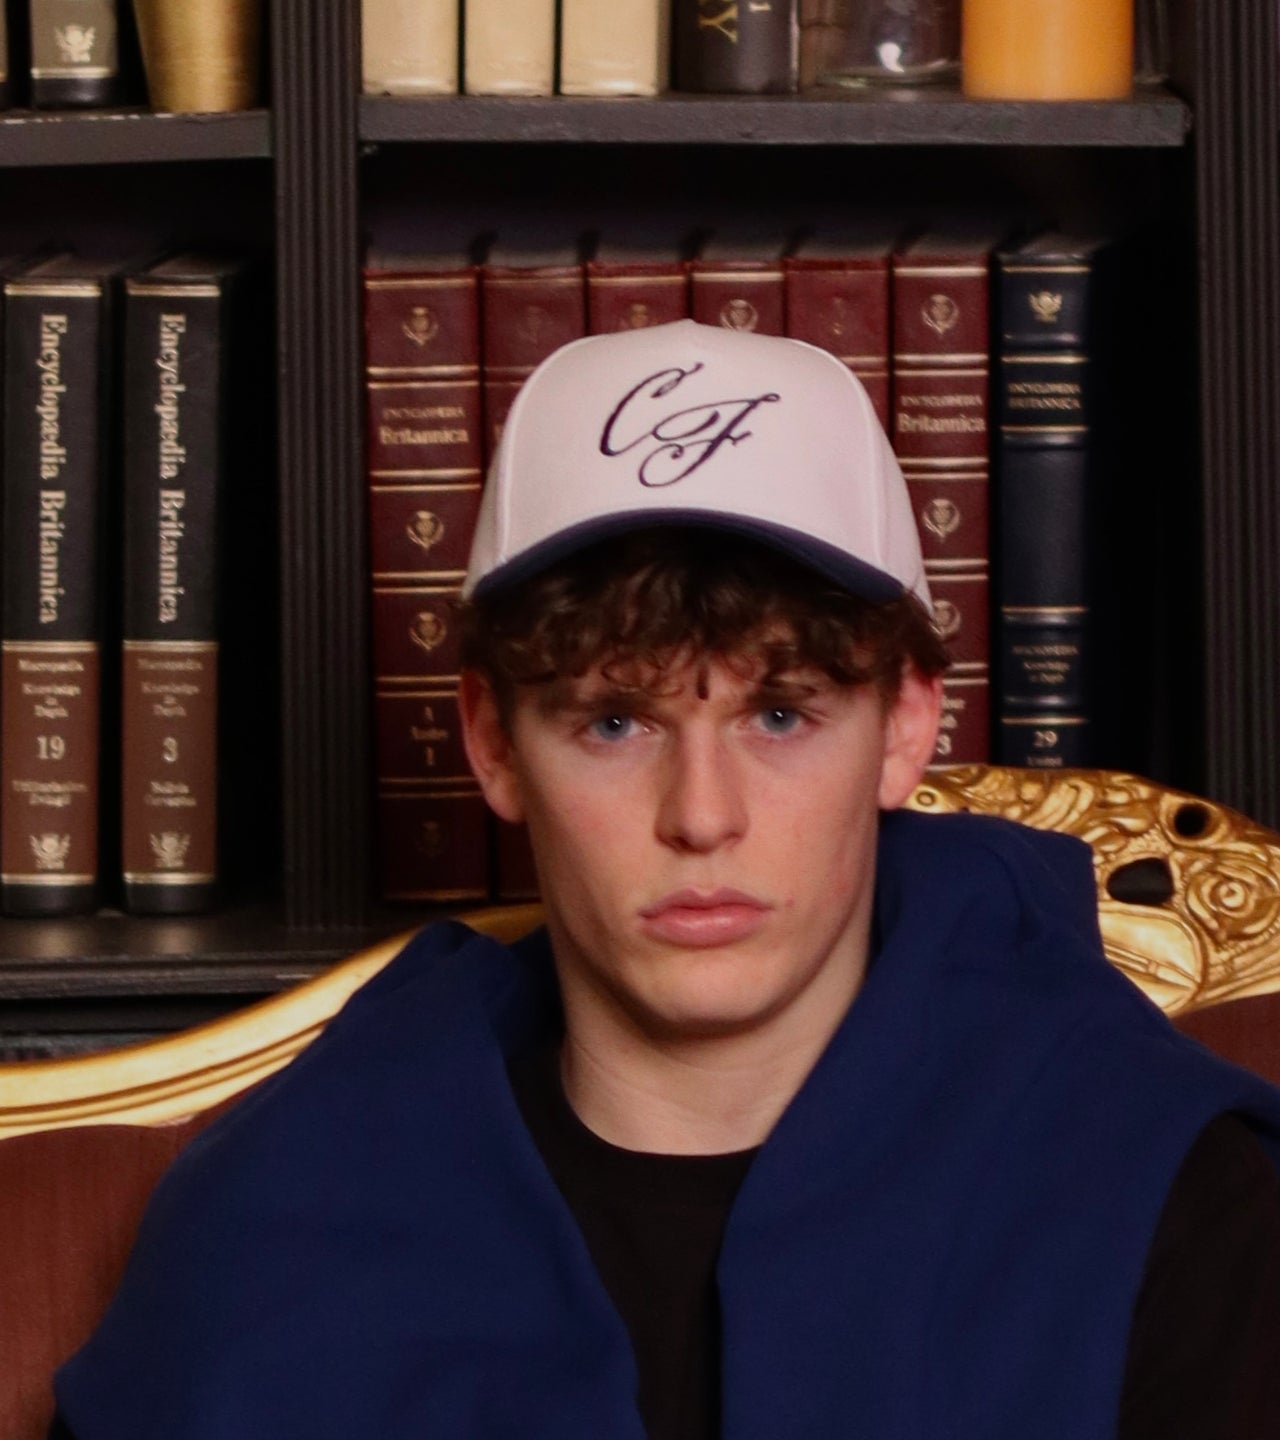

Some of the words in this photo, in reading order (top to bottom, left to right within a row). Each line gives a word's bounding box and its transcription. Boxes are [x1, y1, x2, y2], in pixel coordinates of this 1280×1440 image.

[379, 426, 469, 445] Britannica
[898, 412, 986, 433] Britannica
[40, 490, 66, 624] Britannica
[159, 489, 185, 623] Britannica
[36, 735, 66, 761] 19
[161, 735, 179, 763] 3
